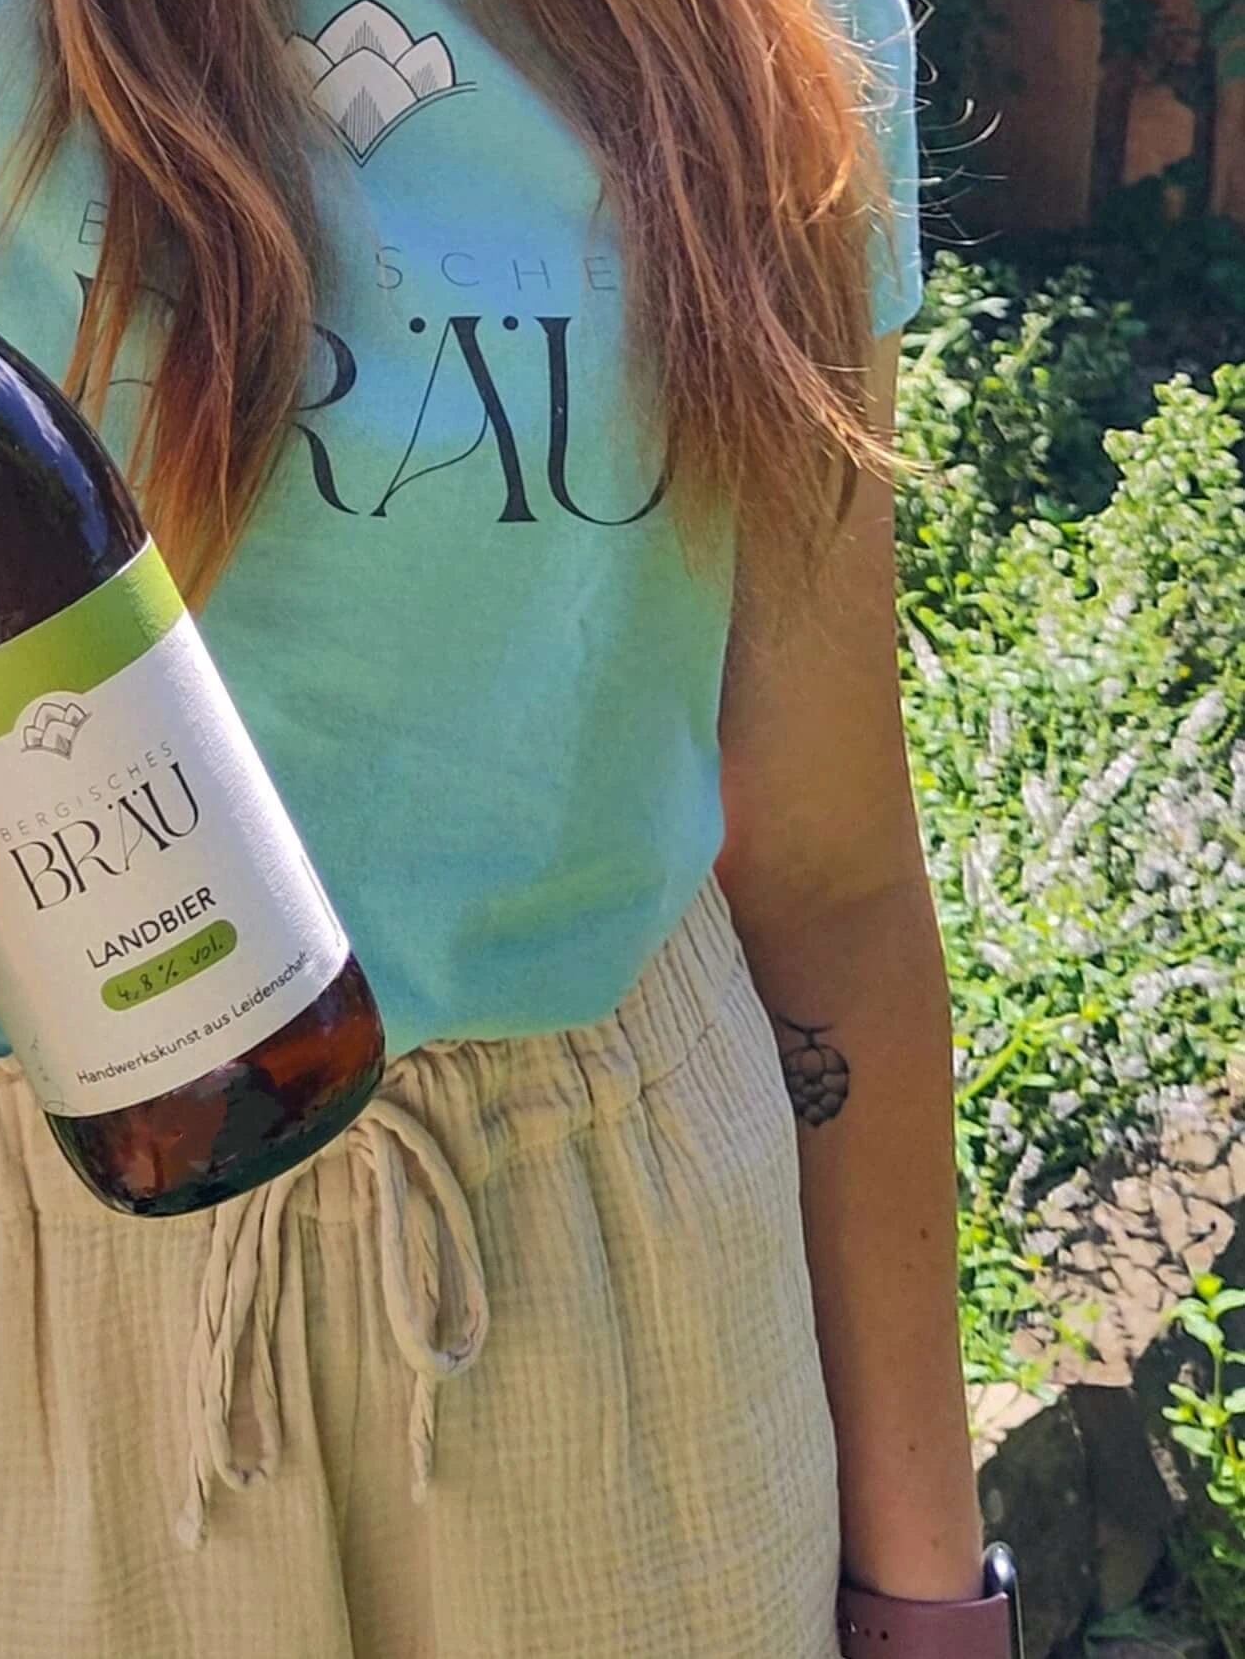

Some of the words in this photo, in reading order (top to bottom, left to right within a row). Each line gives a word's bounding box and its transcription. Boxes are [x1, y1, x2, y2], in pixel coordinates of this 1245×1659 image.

[9, 761, 199, 911] BRÄU
[86, 886, 217, 969] LANDBIER
[189, 934, 224, 965] vol.
[76, 1030, 202, 1086] Handwerkskunst
[204, 1014, 231, 1037] aus
